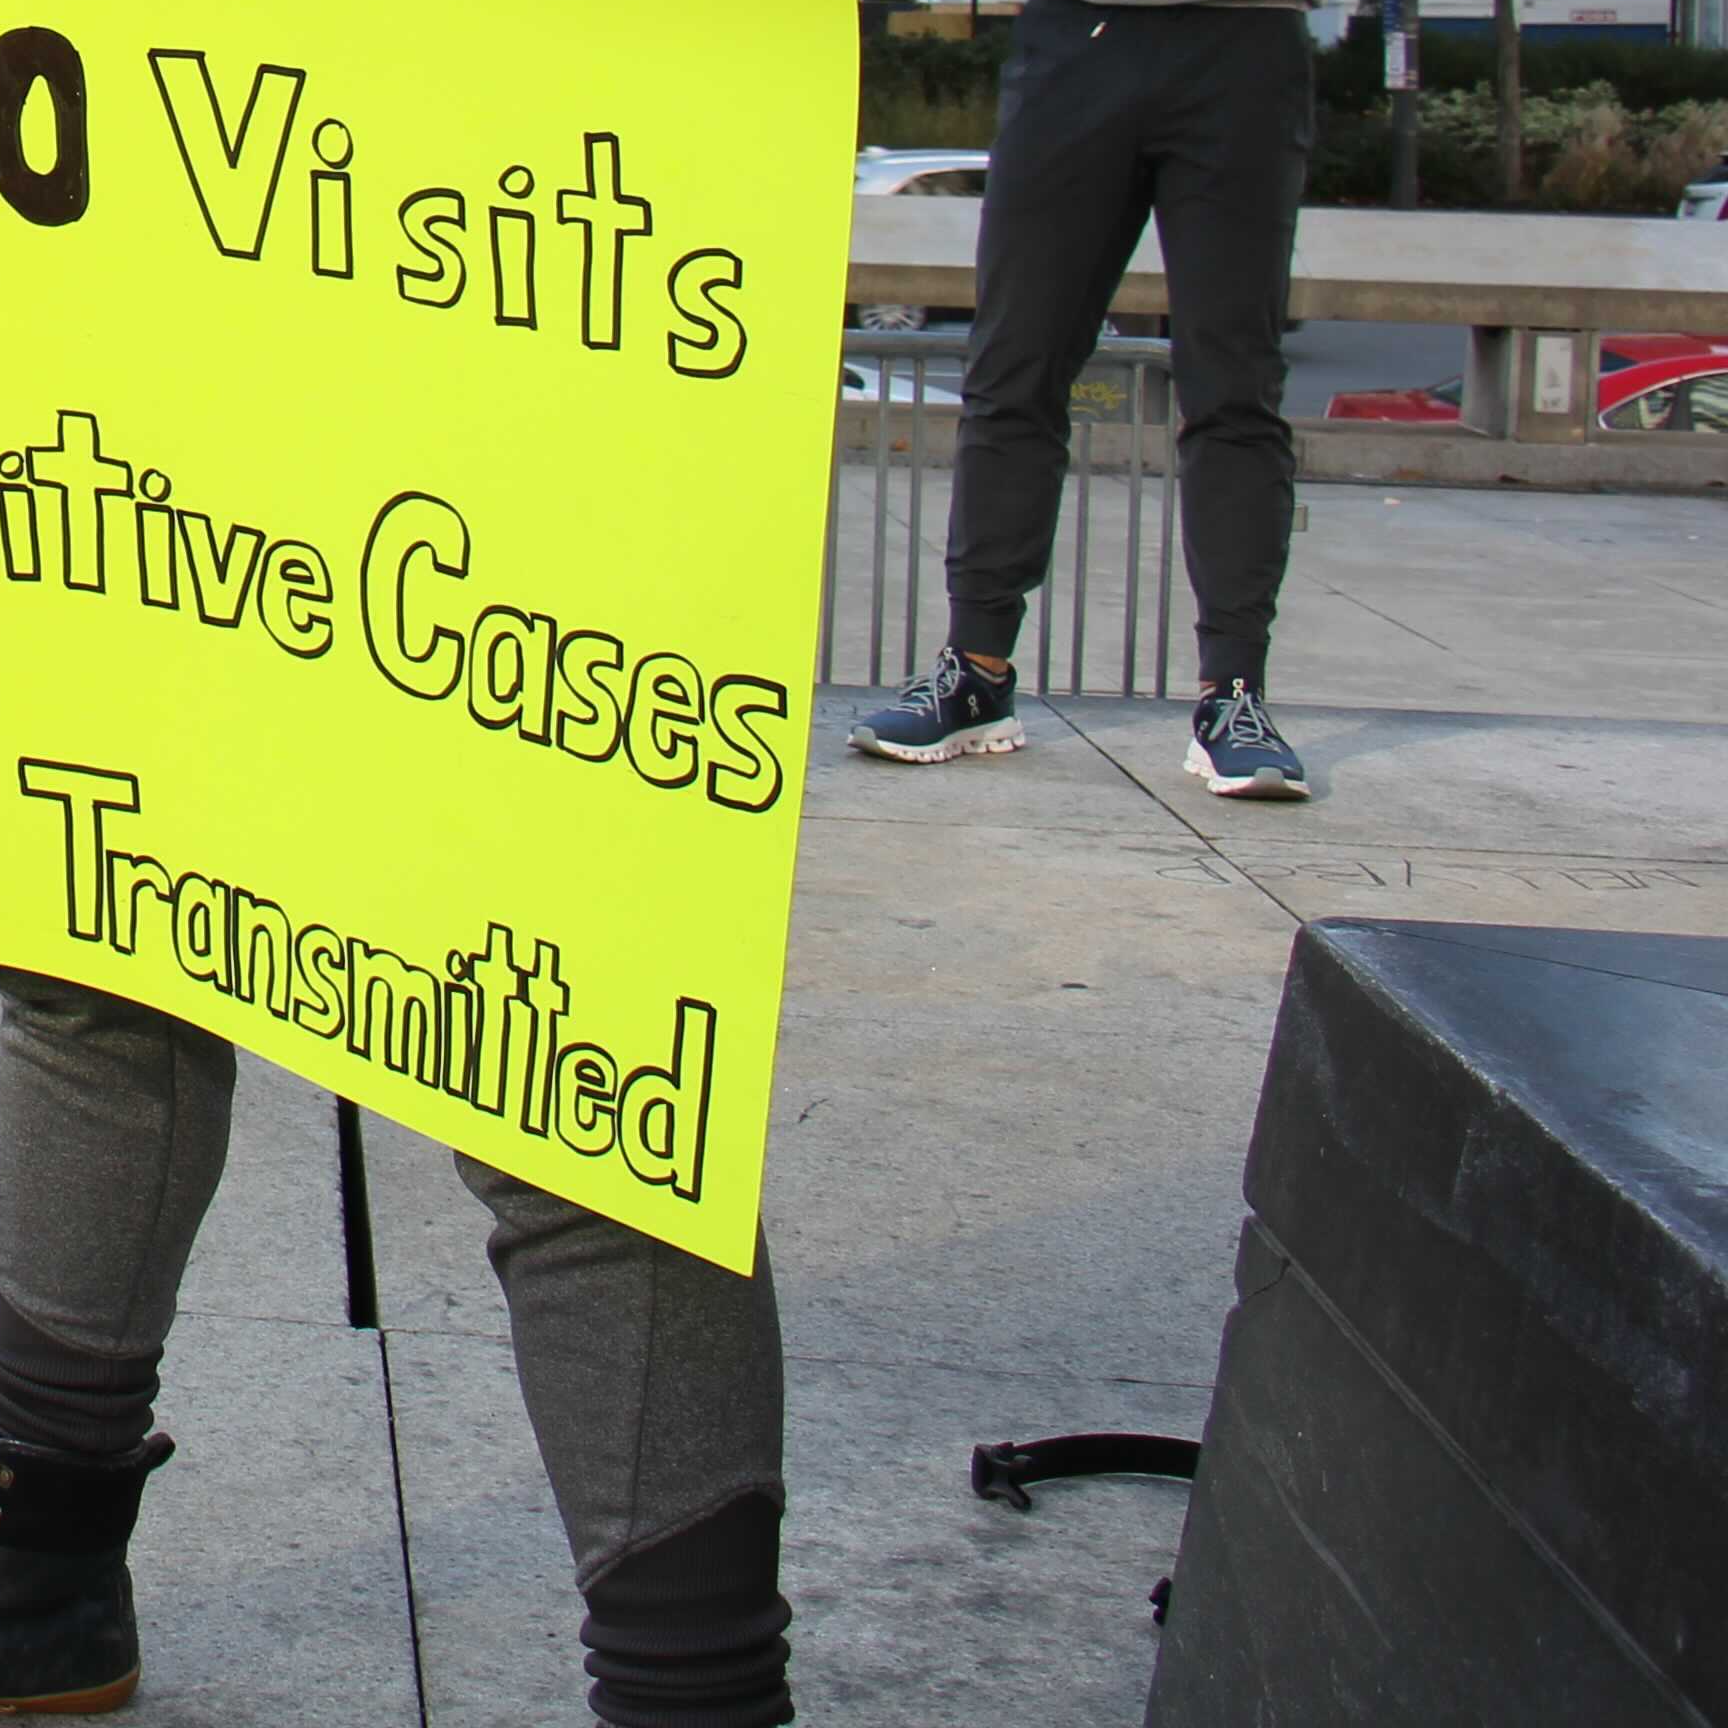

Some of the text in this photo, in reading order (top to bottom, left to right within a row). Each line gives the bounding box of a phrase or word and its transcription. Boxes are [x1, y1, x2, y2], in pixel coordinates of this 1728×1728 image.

[147, 48, 747, 379] Visits
[361, 491, 789, 813] Cases
[18, 754, 717, 1204] Transmitted
